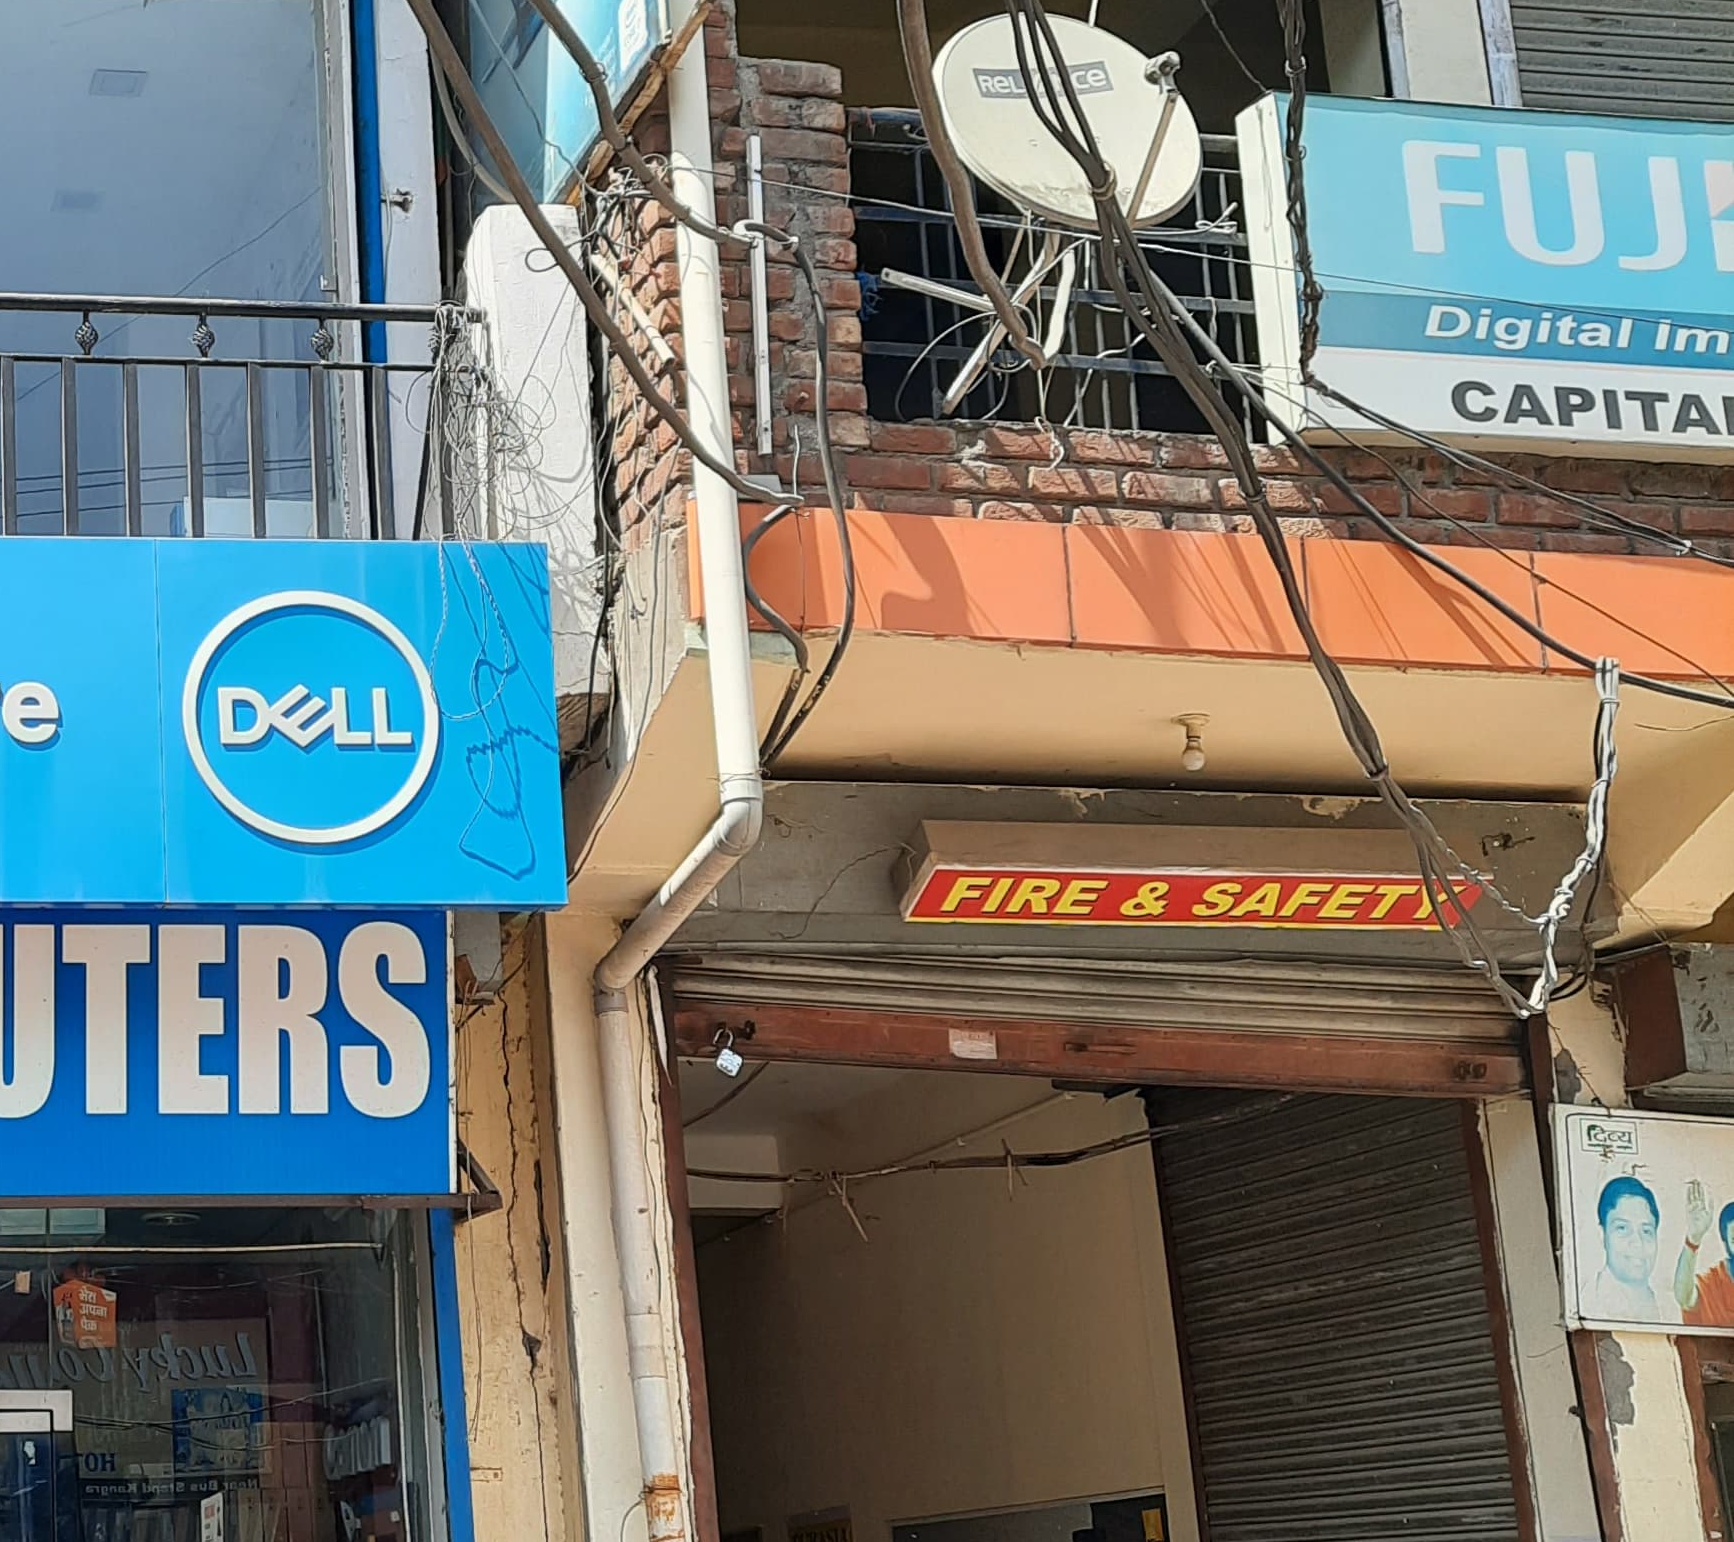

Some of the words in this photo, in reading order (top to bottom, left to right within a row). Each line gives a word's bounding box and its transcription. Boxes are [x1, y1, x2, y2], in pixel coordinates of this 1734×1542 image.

[977, 67, 1109, 95] ReLce
[1422, 302, 1634, 355] Digital
[216, 683, 414, 749] DELL
[940, 876, 1109, 916] FIRE
[1122, 878, 1171, 919] &
[1192, 880, 1468, 923] SAFETY
